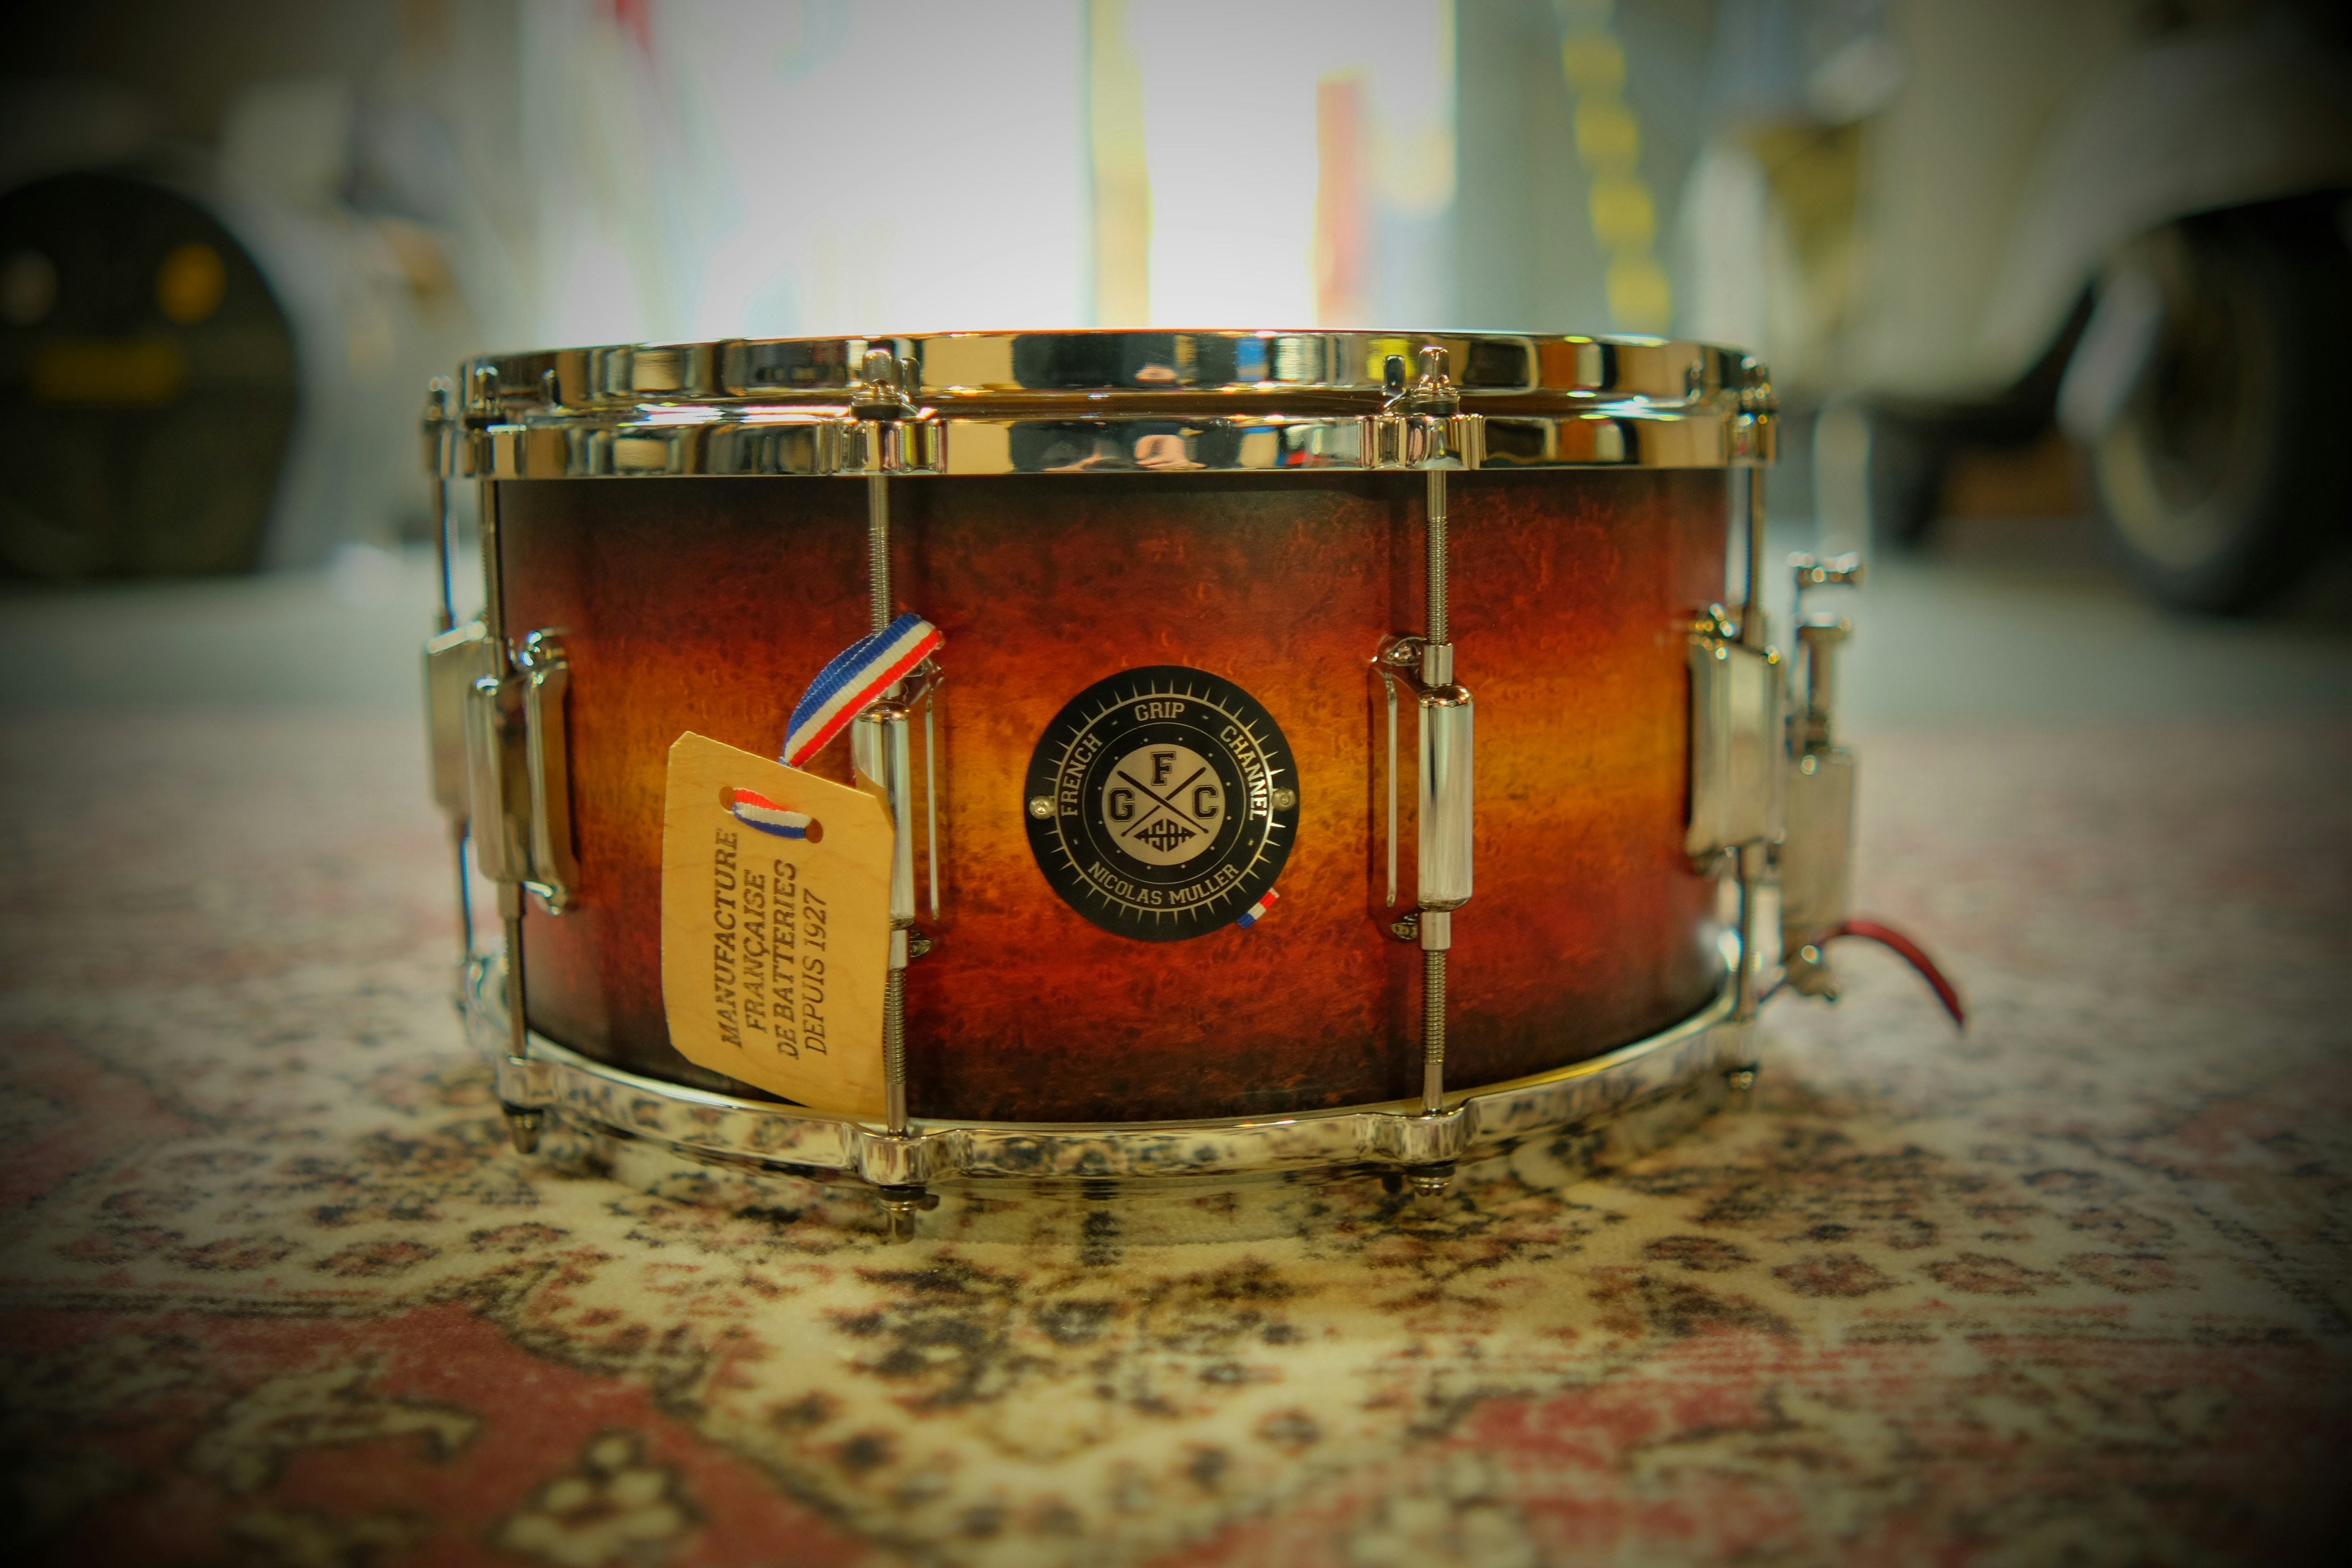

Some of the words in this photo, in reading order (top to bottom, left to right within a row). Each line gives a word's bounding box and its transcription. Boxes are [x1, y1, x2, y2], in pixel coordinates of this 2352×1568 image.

[1061, 733, 1102, 816] FRENCH
[1134, 702, 1186, 722] GRIP
[1220, 725, 1269, 821] CHANNEL
[1151, 751, 1176, 786] F
[1108, 788, 1135, 822] G
[1192, 785, 1219, 820] C
[1088, 862, 1163, 904] NICOLAS
[1169, 864, 1239, 905] MULLER
[714, 827, 742, 1049] MANUFACTURE
[743, 869, 770, 1034] FRANÇAISE
[772, 859, 798, 1023] BATTERIES
[803, 888, 827, 952] 1927
[803, 955, 827, 1056] DEPUIS
[773, 1025, 800, 1060] DE
